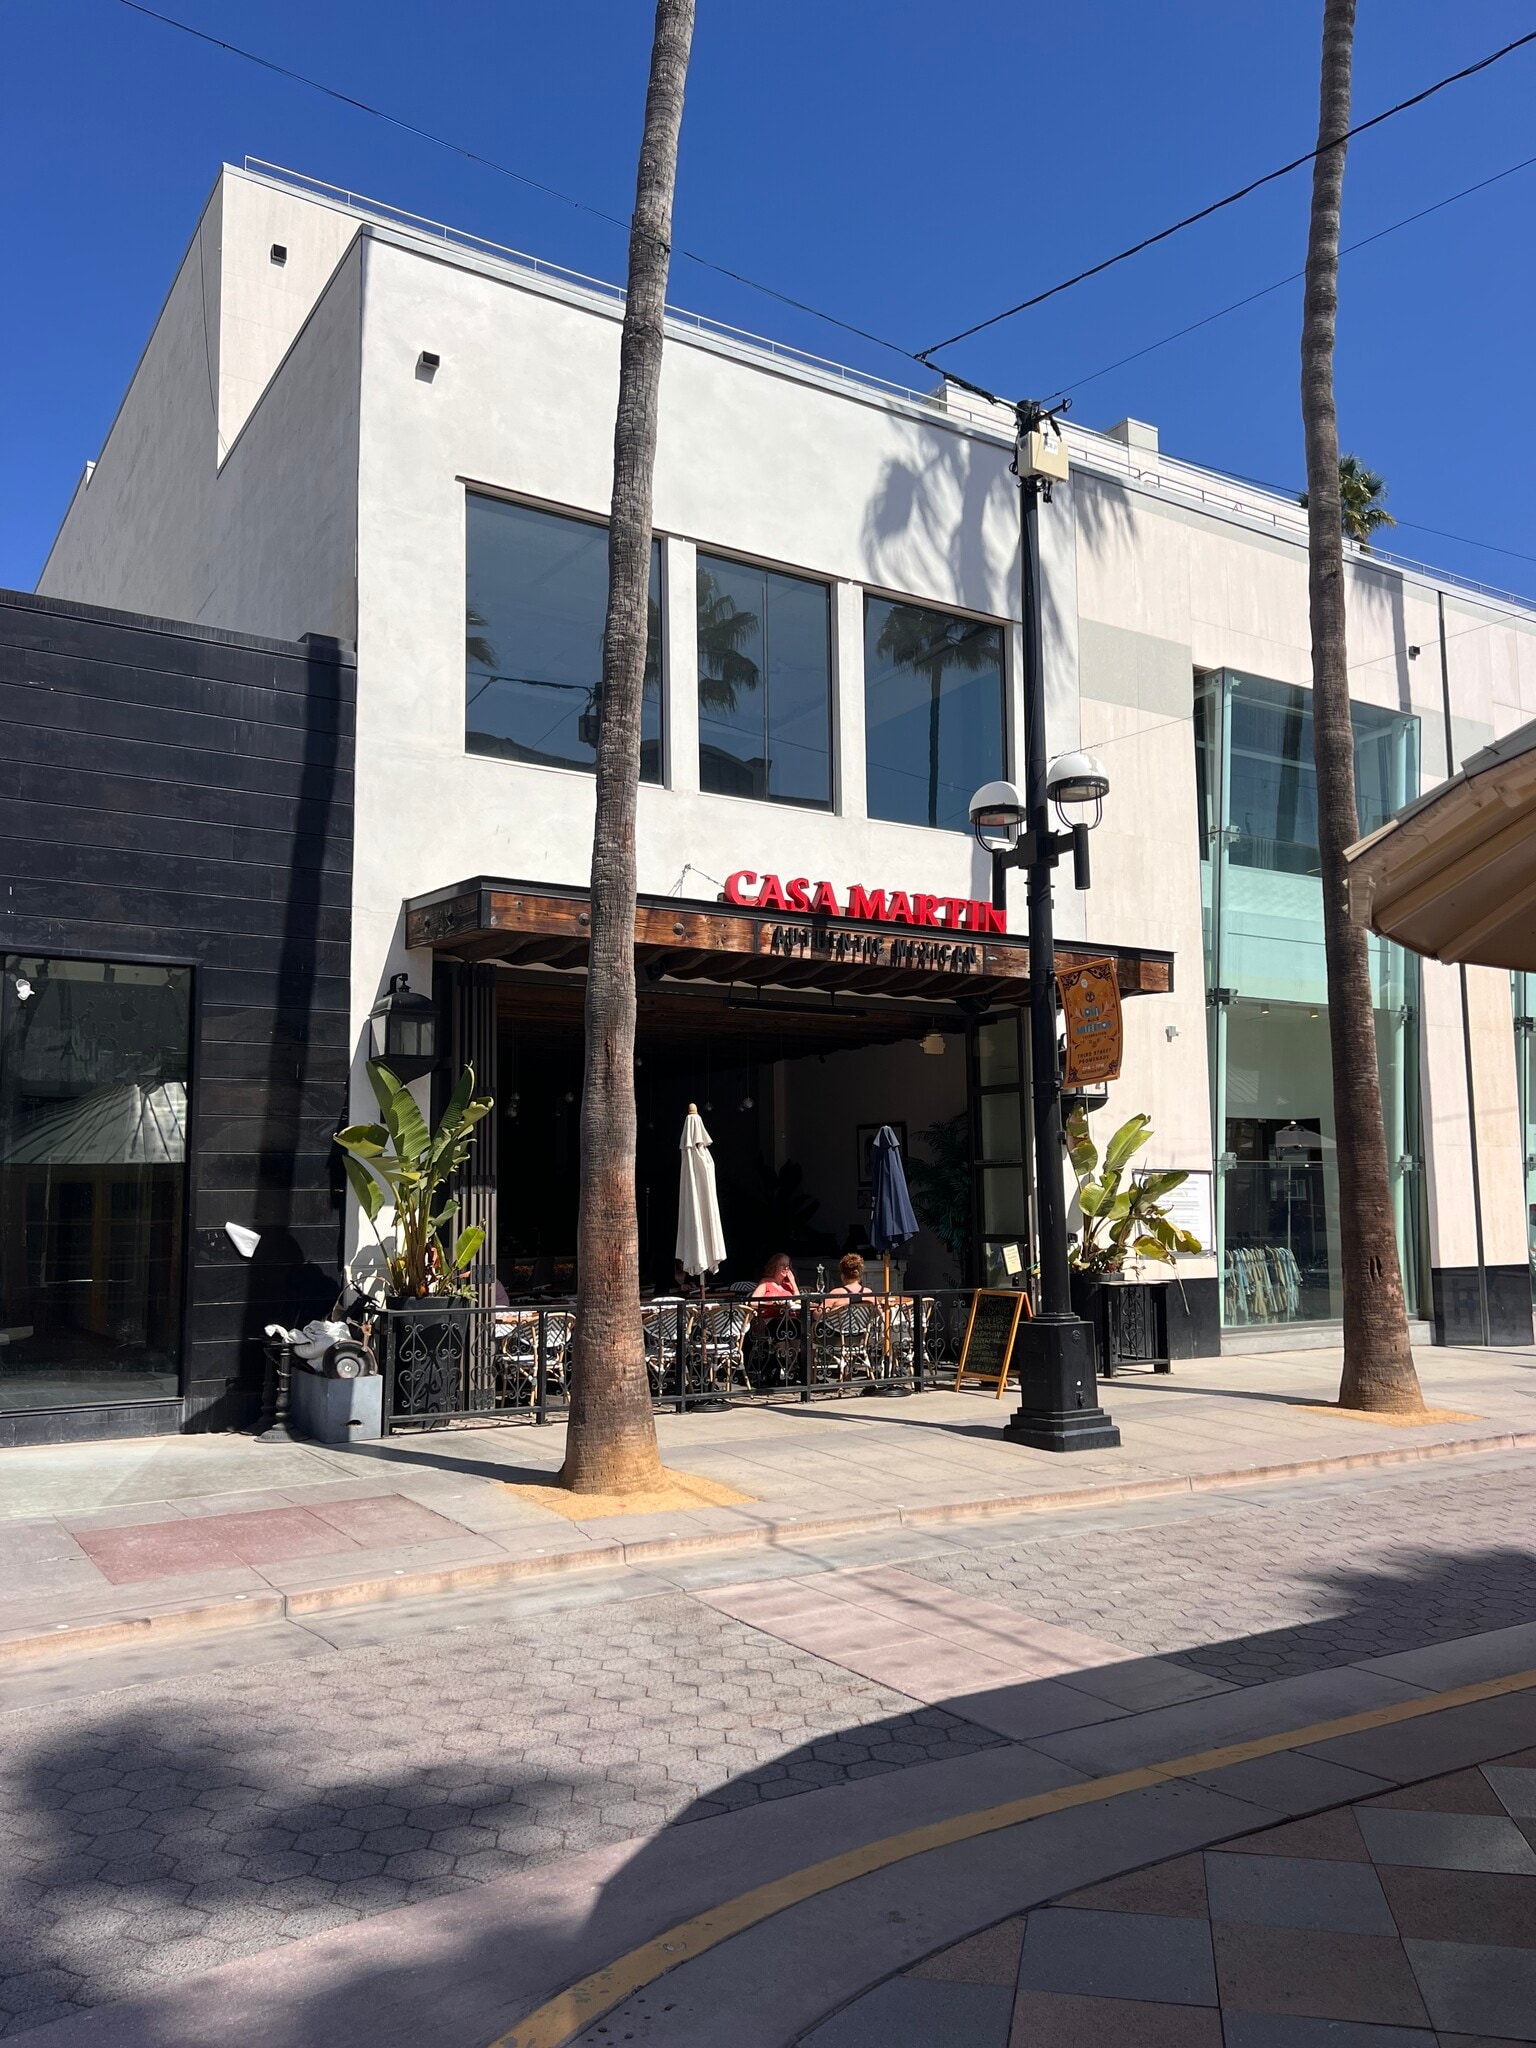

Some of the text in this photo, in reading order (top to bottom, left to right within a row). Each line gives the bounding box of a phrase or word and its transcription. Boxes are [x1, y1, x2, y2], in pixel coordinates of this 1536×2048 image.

[724, 870, 1007, 934] CASA MARTIN
[773, 926, 977, 964] AUTHENTIC MEXICAN
[1077, 1047, 1112, 1059] THIRD STREET
[1078, 1054, 1109, 1064] PROMENADE
